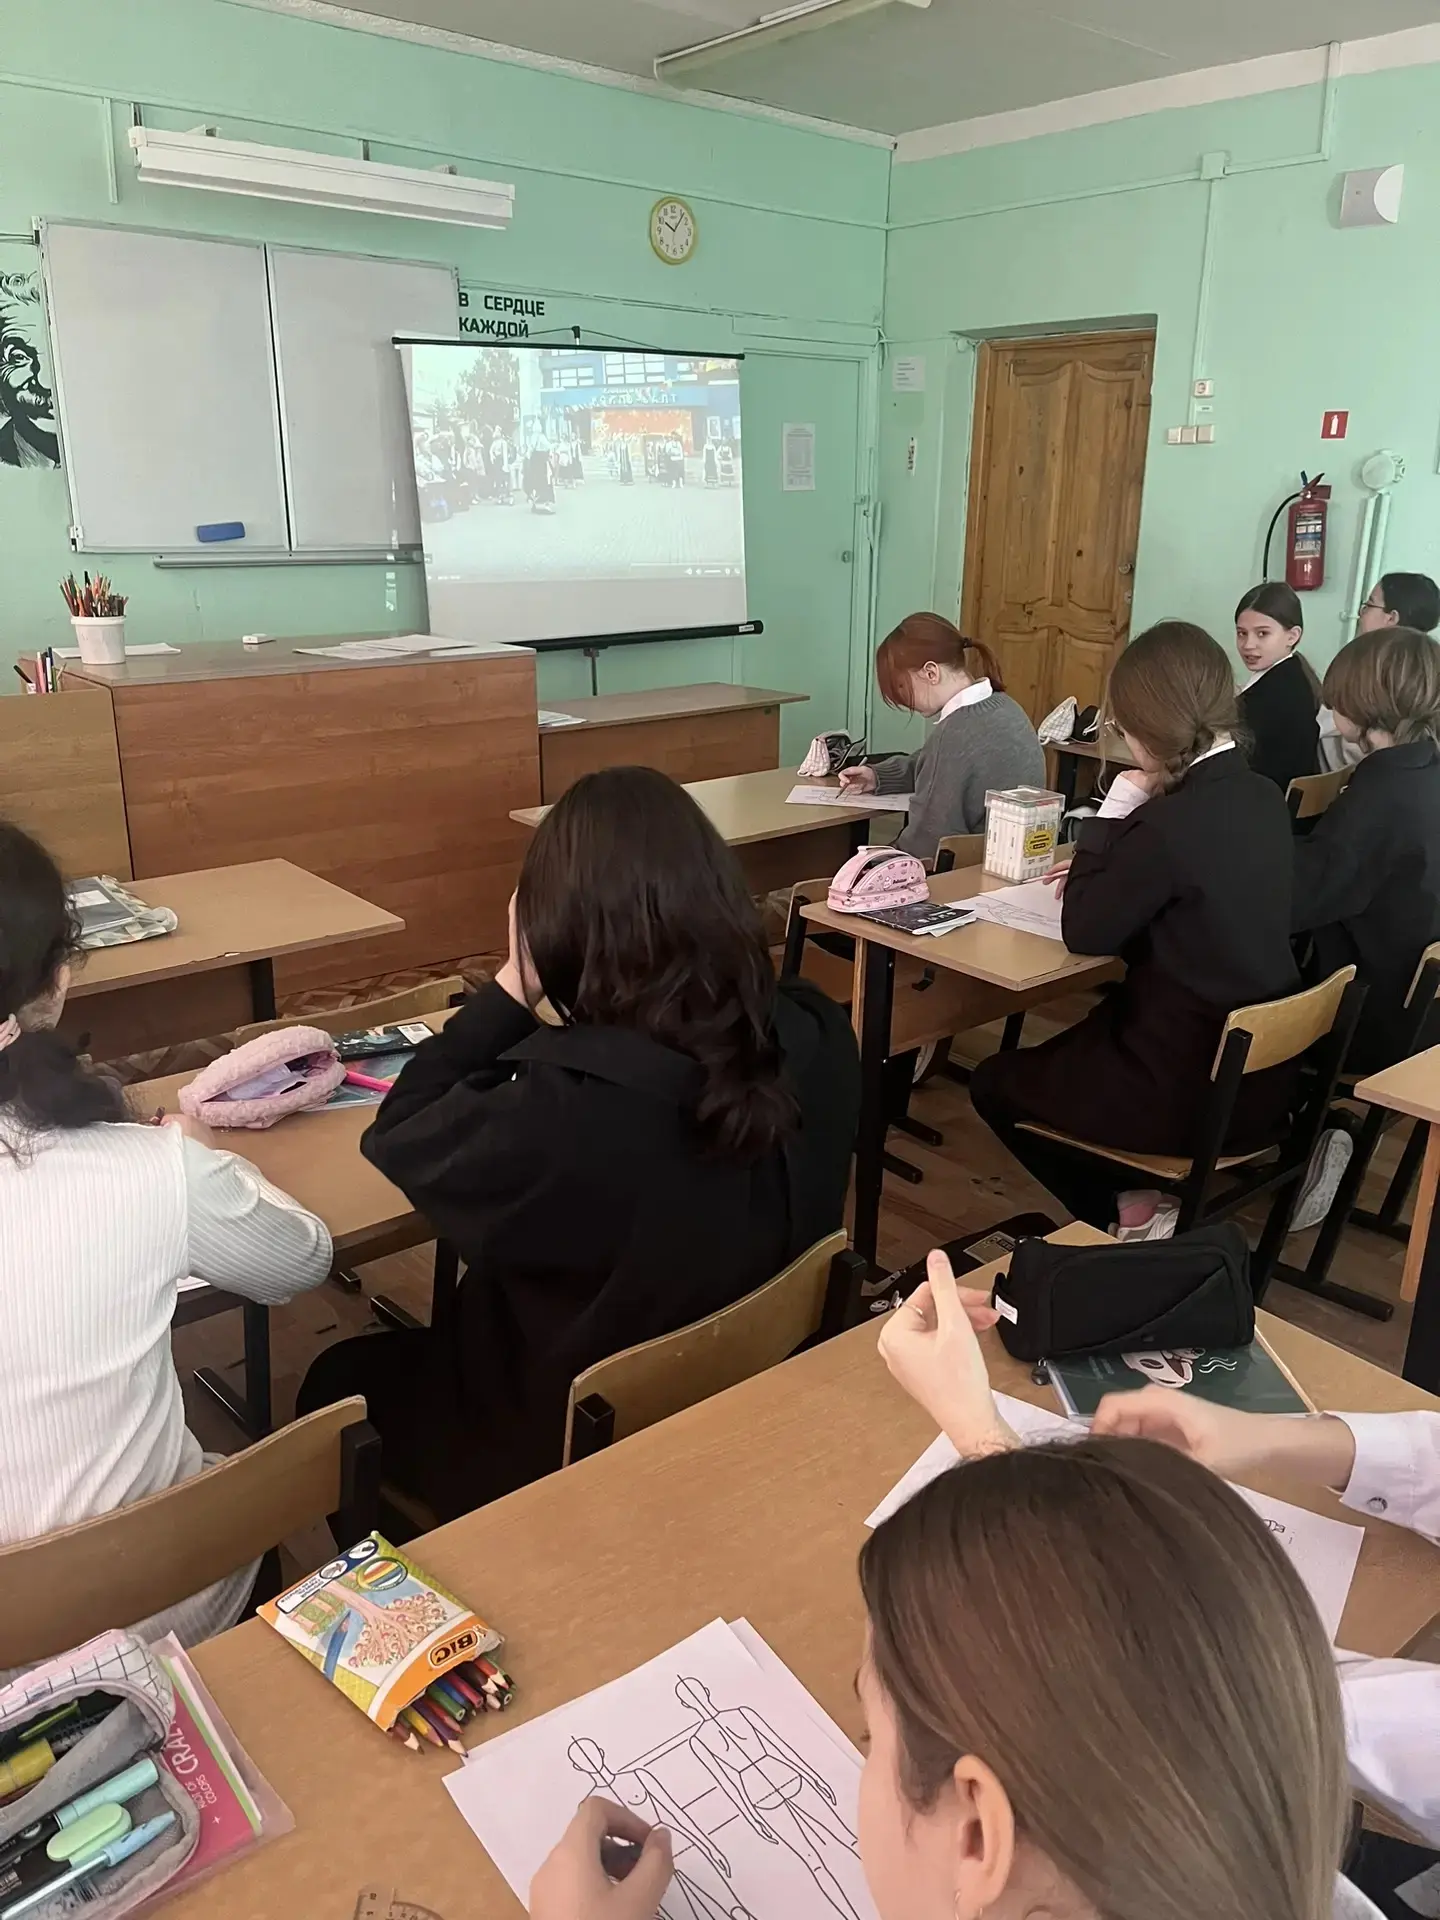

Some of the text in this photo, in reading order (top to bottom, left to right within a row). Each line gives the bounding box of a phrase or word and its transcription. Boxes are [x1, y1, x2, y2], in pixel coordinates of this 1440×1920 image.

[458, 292, 545, 318] В СЕРДЦЕ
[459, 316, 528, 338] КАЖДОЙ
[434, 1633, 473, 1664] BIC
